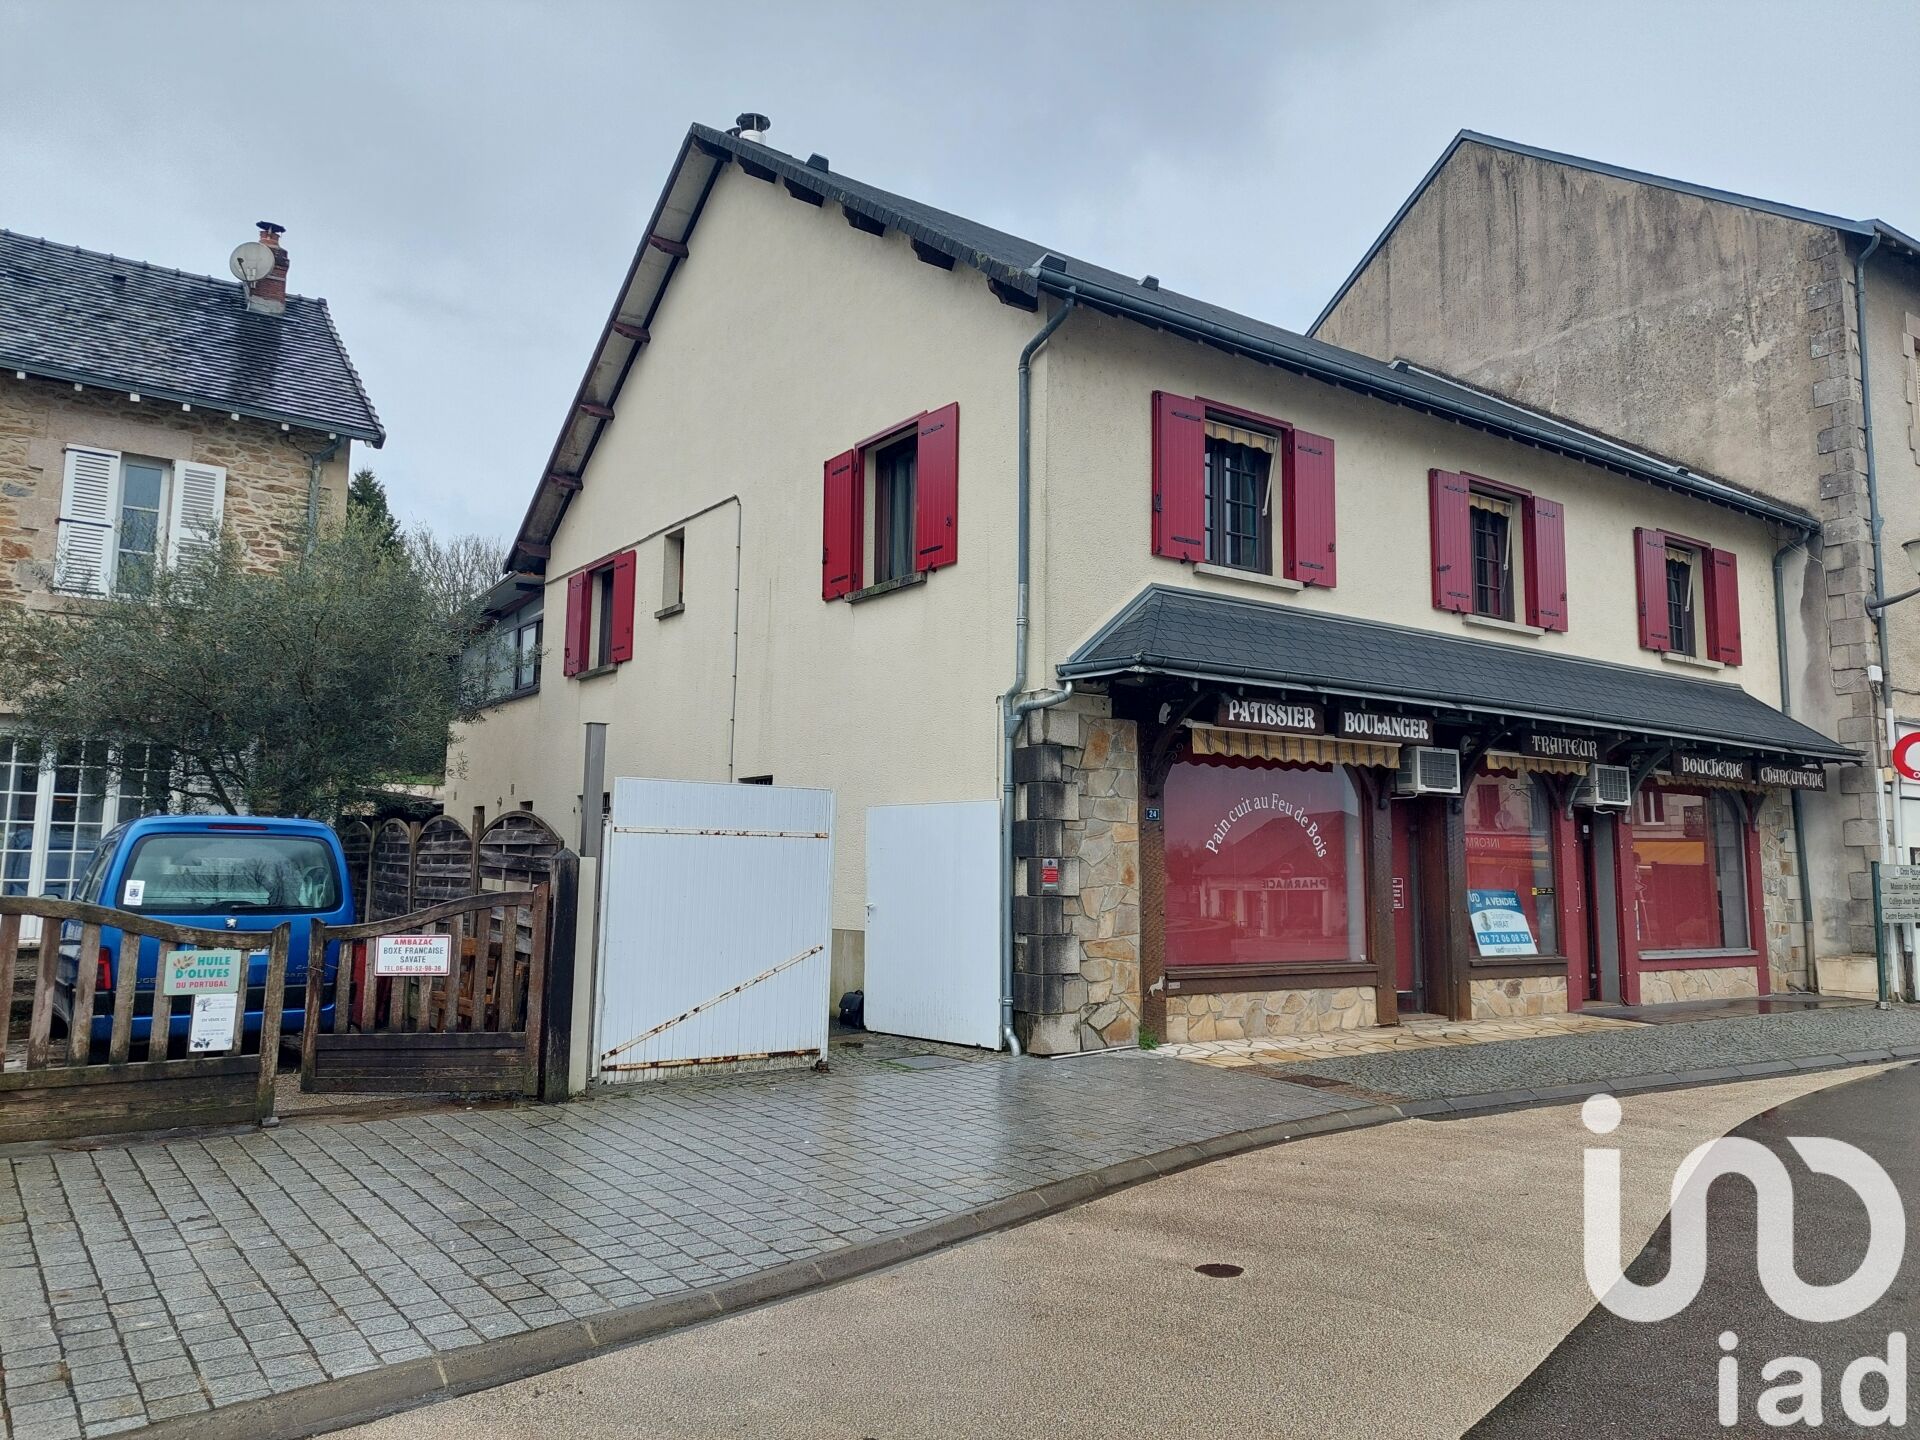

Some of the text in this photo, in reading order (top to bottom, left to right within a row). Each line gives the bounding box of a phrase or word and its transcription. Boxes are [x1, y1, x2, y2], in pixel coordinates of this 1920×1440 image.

[1228, 700, 1316, 730] PATISSIER
[1344, 711, 1429, 740] BOULANGER
[1531, 735, 1598, 760] TRAITEUR
[1681, 756, 1744, 780] BOUCHERIE
[1760, 765, 1824, 789] CHARCUTERIE
[1148, 810, 1157, 818] 24
[1205, 792, 1327, 858] Pain cuit au Feu de Bois
[393, 938, 433, 946] AMBAZAC
[383, 946, 402, 955] BOXE
[197, 956, 232, 966] HUILE
[399, 955, 427, 963] SAVATE
[175, 968, 230, 979] D'OLIVES
[175, 980, 229, 989] DU PORTUGAL
